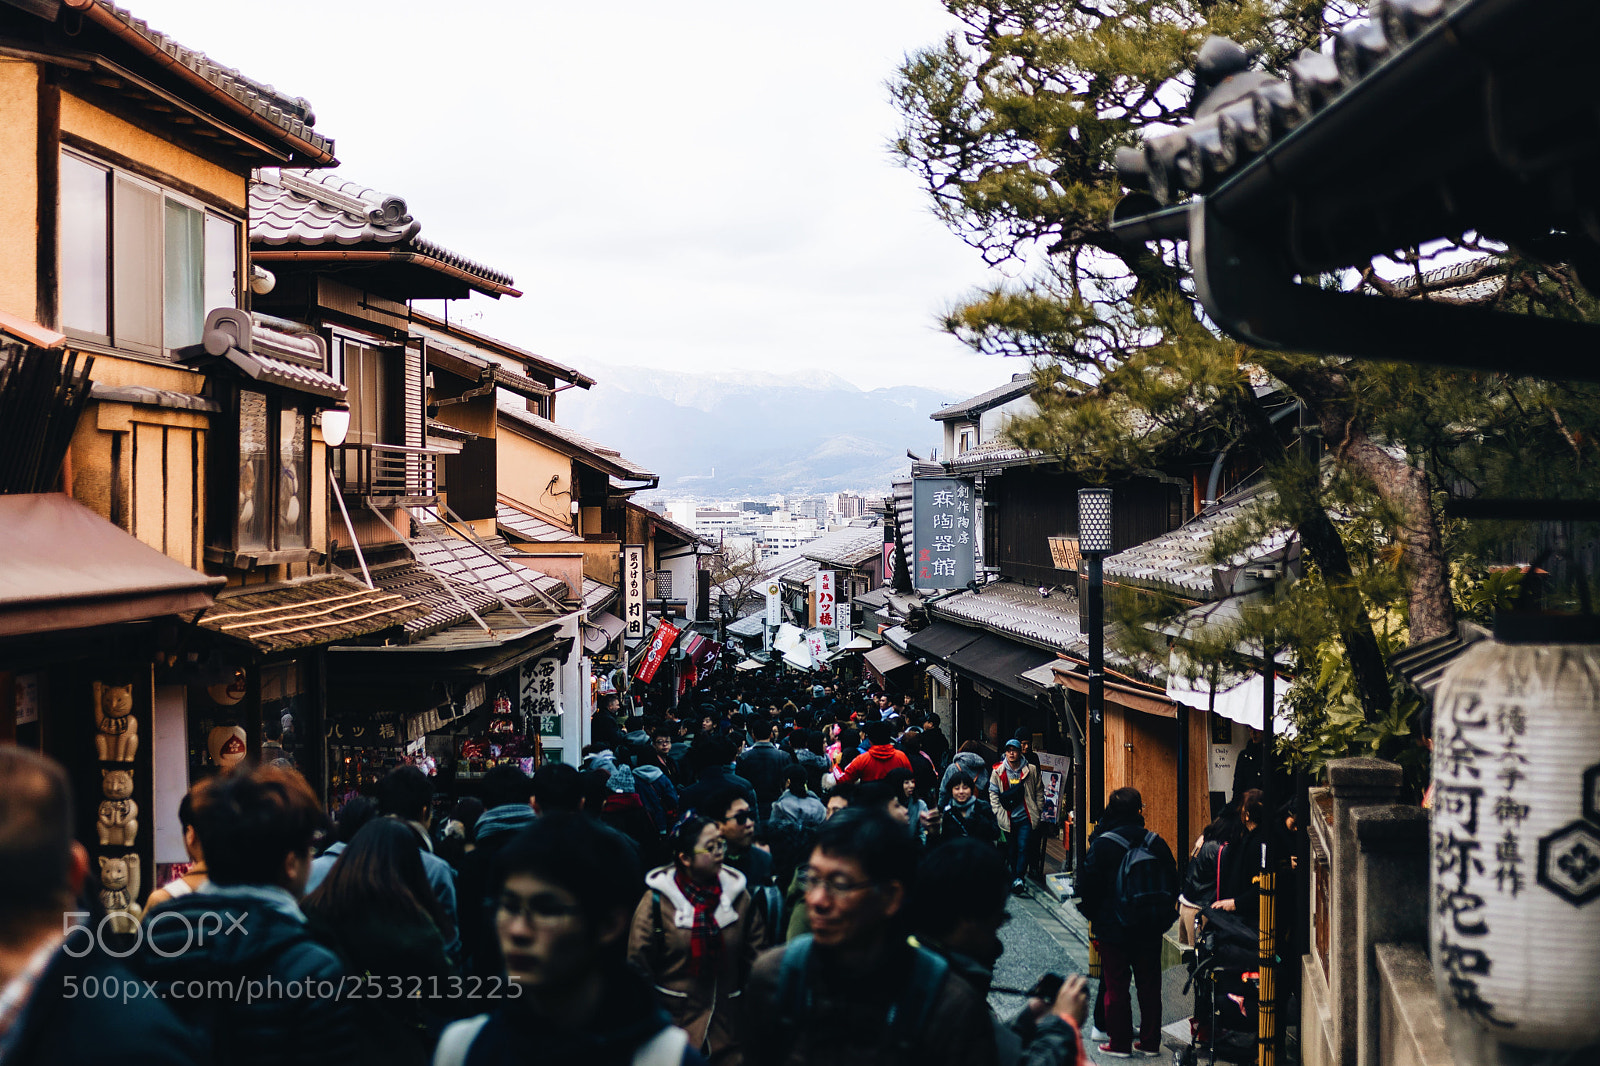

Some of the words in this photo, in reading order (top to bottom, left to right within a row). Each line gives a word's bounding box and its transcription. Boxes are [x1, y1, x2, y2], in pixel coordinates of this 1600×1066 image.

[931, 490, 956, 576] 森陶器館
[629, 552, 639, 597] 京つけもの
[628, 602, 641, 633] 打田
[539, 661, 556, 715] 西陣織
